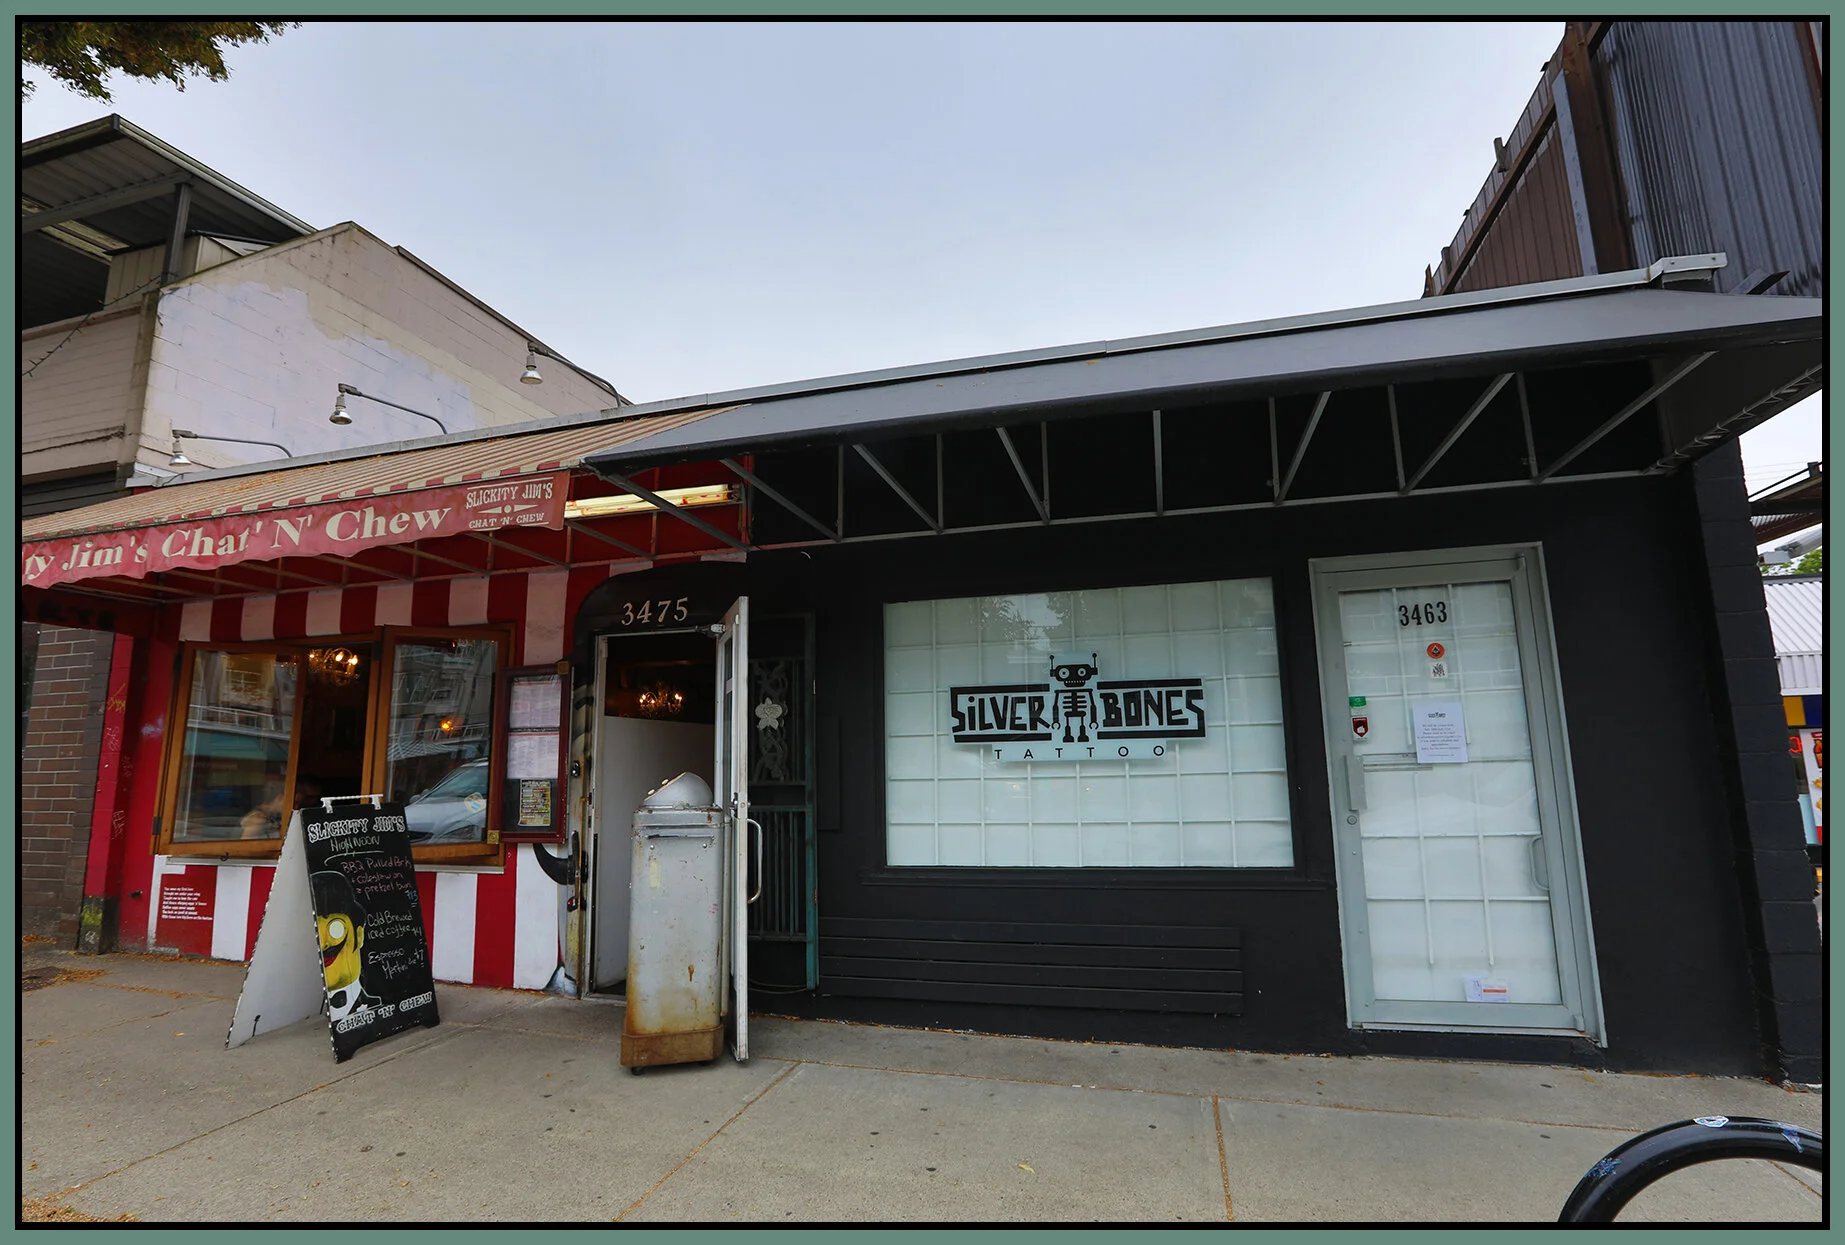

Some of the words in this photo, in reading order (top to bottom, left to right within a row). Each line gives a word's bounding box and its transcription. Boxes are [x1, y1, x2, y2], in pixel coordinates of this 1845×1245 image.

[465, 486, 519, 510] SLICKITY
[522, 482, 553, 500] JIM'S
[468, 517, 497, 529] CHAT
[516, 513, 545, 524] CHEW
[62, 535, 148, 571] Jim's
[325, 505, 452, 542] Chew
[621, 597, 688, 626] 3475
[1398, 601, 1448, 627] 3463
[1101, 688, 1206, 736] BONES
[994, 745, 1165, 760] TATTOO
[307, 817, 369, 844] SLICKITY
[372, 815, 406, 833] JIM'S
[367, 911, 385, 927] Cold
[336, 1010, 375, 1034] CHAT
[399, 991, 433, 1012] CHEW
